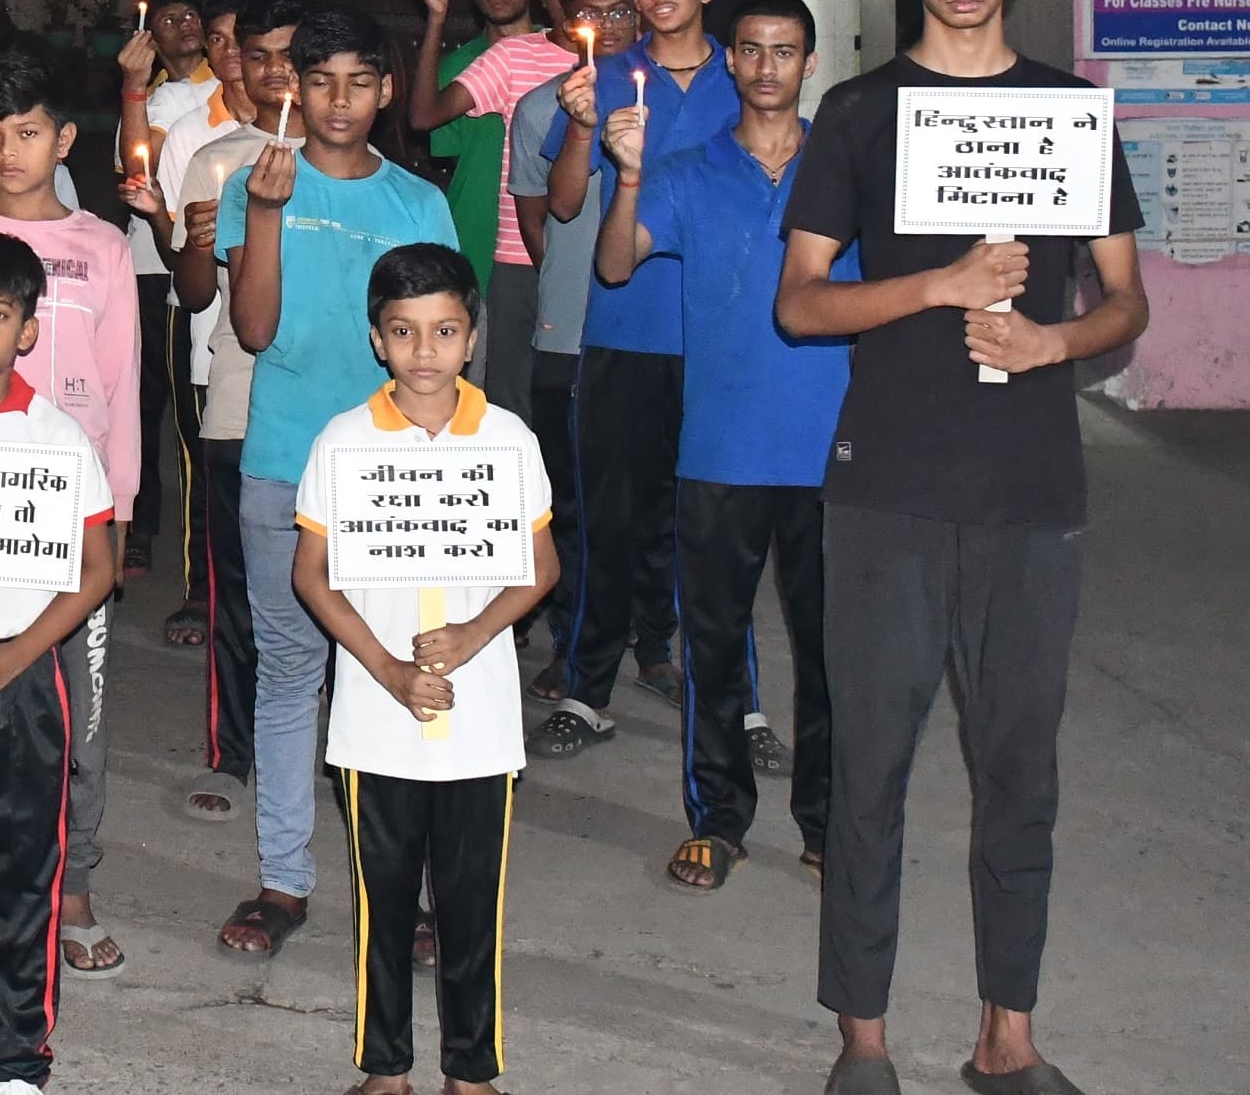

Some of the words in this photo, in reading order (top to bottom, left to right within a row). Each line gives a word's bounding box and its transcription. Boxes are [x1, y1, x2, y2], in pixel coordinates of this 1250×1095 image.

[1178, 19, 1232, 31] Contact
[1101, 37, 1136, 46] Online
[1139, 36, 1204, 48] Registration
[1206, 36, 1250, 46] Availabl
[1073, 112, 1098, 131] ने
[955, 140, 1020, 155] ठाना
[1039, 136, 1054, 155] है
[937, 162, 1067, 184] आतंकवाद
[937, 185, 1035, 206] मिटाना
[1052, 187, 1068, 206] है
[360, 464, 443, 483] जीवन
[461, 463, 494, 482] की
[439, 488, 490, 507] करो
[14, 499, 36, 524] तो
[339, 515, 468, 535] आतंकवाद
[486, 518, 519, 532] का
[368, 545, 426, 558] नाश
[443, 538, 494, 558] करो
